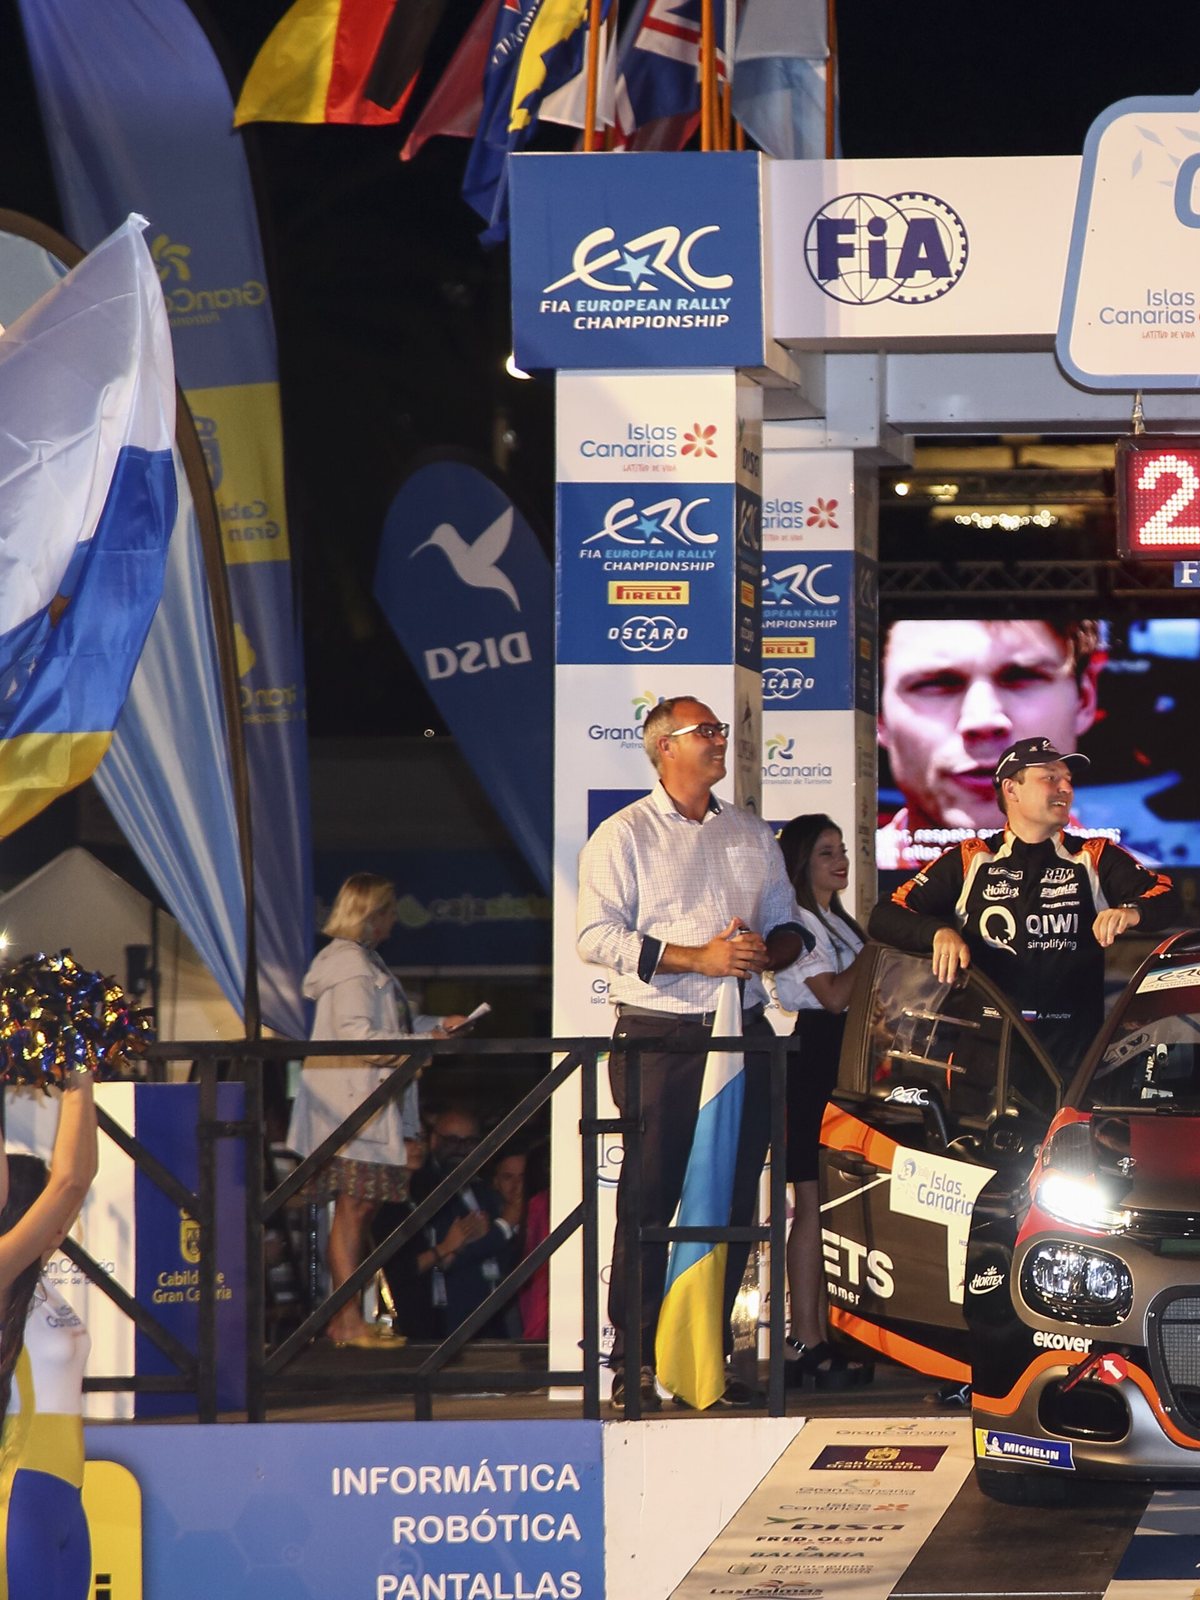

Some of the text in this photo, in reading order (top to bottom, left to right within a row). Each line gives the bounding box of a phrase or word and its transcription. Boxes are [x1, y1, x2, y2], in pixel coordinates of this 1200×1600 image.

[817, 216, 952, 280] FIA
[543, 225, 734, 293] ERC
[540, 297, 732, 313] FIA EUROPEAN RALLY
[1147, 289, 1195, 306] Islas
[573, 314, 730, 330] CHAMPIONSHIP
[1100, 307, 1196, 325] Canarias
[628, 423, 677, 441] Islas
[580, 440, 677, 458] Canarias
[762, 499, 803, 513] slas
[582, 498, 719, 545] ERC
[762, 514, 803, 529] arias
[580, 549, 717, 559] FIA EUROPEAN RALLY
[603, 561, 715, 571] CHAMPIONSHIP
[616, 585, 682, 600] PIRELLI
[803, 609, 838, 617] RALLY
[608, 627, 688, 640] OSCARO
[764, 641, 808, 654] RELLI
[762, 677, 815, 689] SCARO
[983, 884, 1020, 900] HORTEX
[1026, 913, 1079, 937] QIWI
[1027, 938, 1078, 951] simplifying
[930, 1171, 962, 1195] Islas
[917, 1184, 974, 1216] Canaria
[971, 1271, 1005, 1290] HORTEX
[153, 1288, 184, 1304] Gran
[827, 1282, 860, 1305] mmer
[1004, 1439, 1060, 1461] MICHELIN
[333, 1459, 580, 1496] INFORMÁTICA
[393, 1508, 580, 1544] ROBÓTICA
[377, 1569, 581, 1600] PANTALLAS
